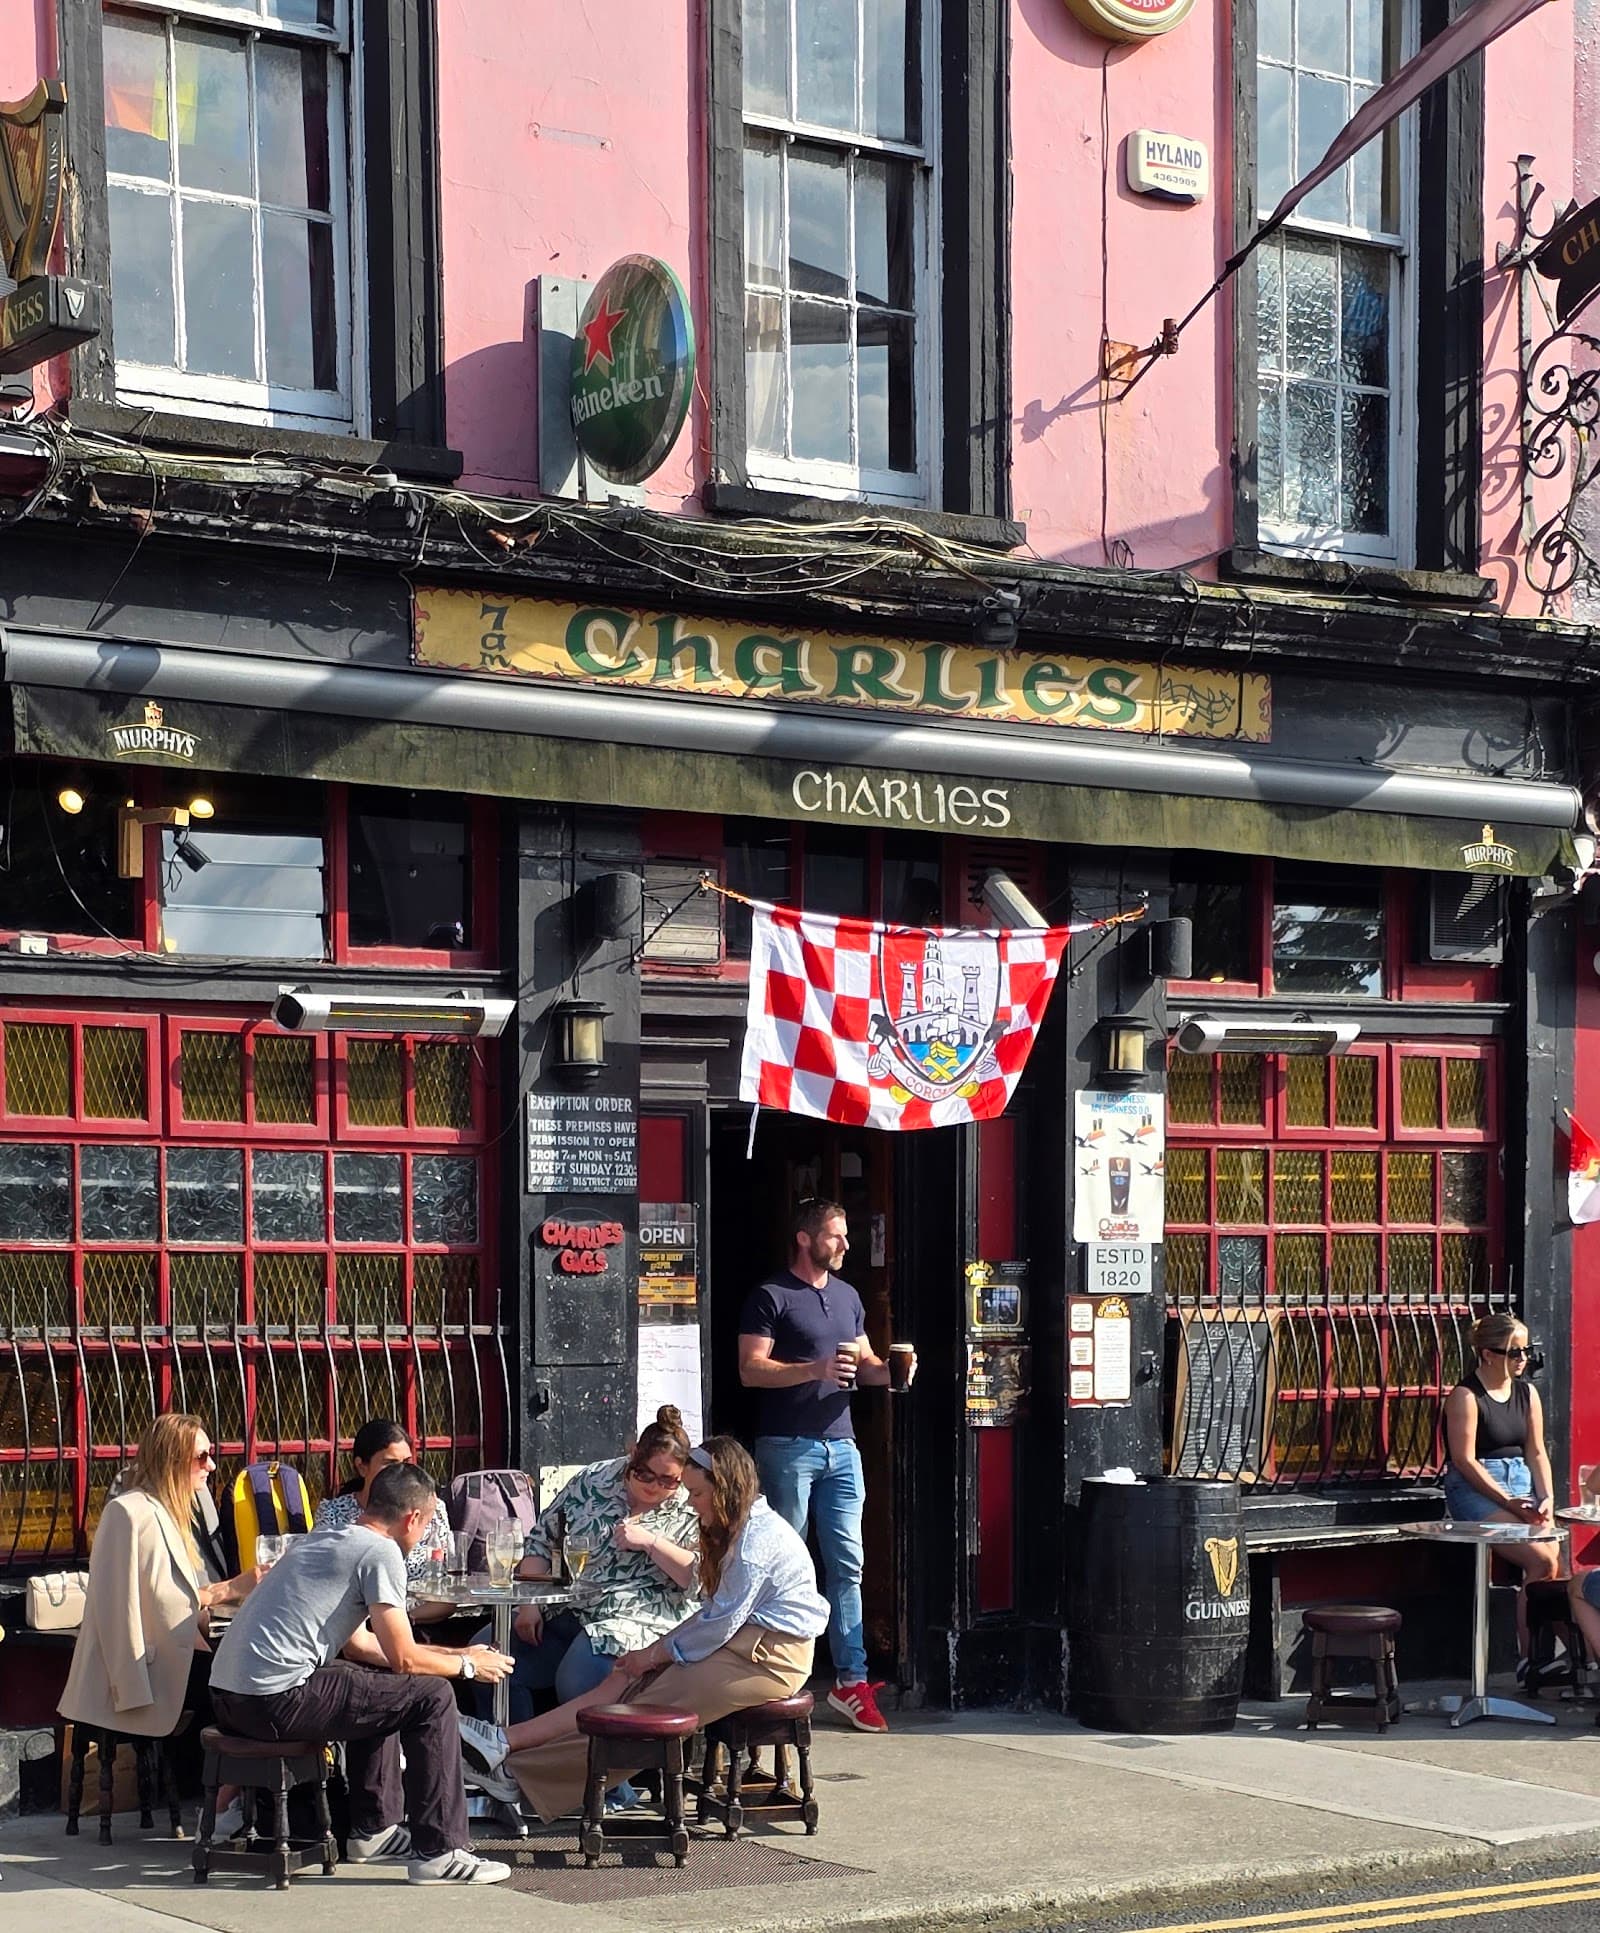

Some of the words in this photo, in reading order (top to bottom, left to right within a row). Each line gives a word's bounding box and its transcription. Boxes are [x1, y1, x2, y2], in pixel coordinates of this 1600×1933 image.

[1146, 140, 1202, 169] HYLAND
[571, 374, 666, 428] Heineken
[529, 1094, 590, 1112] EXEMPTION
[595, 1096, 633, 1113] ORDER
[531, 1119, 563, 1132] THESE
[566, 1121, 612, 1133] PREMISES
[614, 1122, 637, 1134] HAVE
[530, 1134, 590, 1147] PERMISSION
[593, 1137, 605, 1147] TO
[609, 1137, 636, 1148] OPEN
[530, 1149, 560, 1161] FROM
[579, 1150, 602, 1161] MON
[614, 1151, 633, 1163] SAT
[530, 1161, 567, 1175] EXCEPT
[531, 1175, 542, 1187] BY
[572, 1177, 611, 1187] DISTRICT
[614, 1178, 638, 1188] COURT
[542, 1221, 624, 1249] CHARLIES
[639, 1227, 685, 1245] OPEN
[1100, 1270, 1141, 1287] 1820
[1185, 1600, 1250, 1620] GUINNESS
